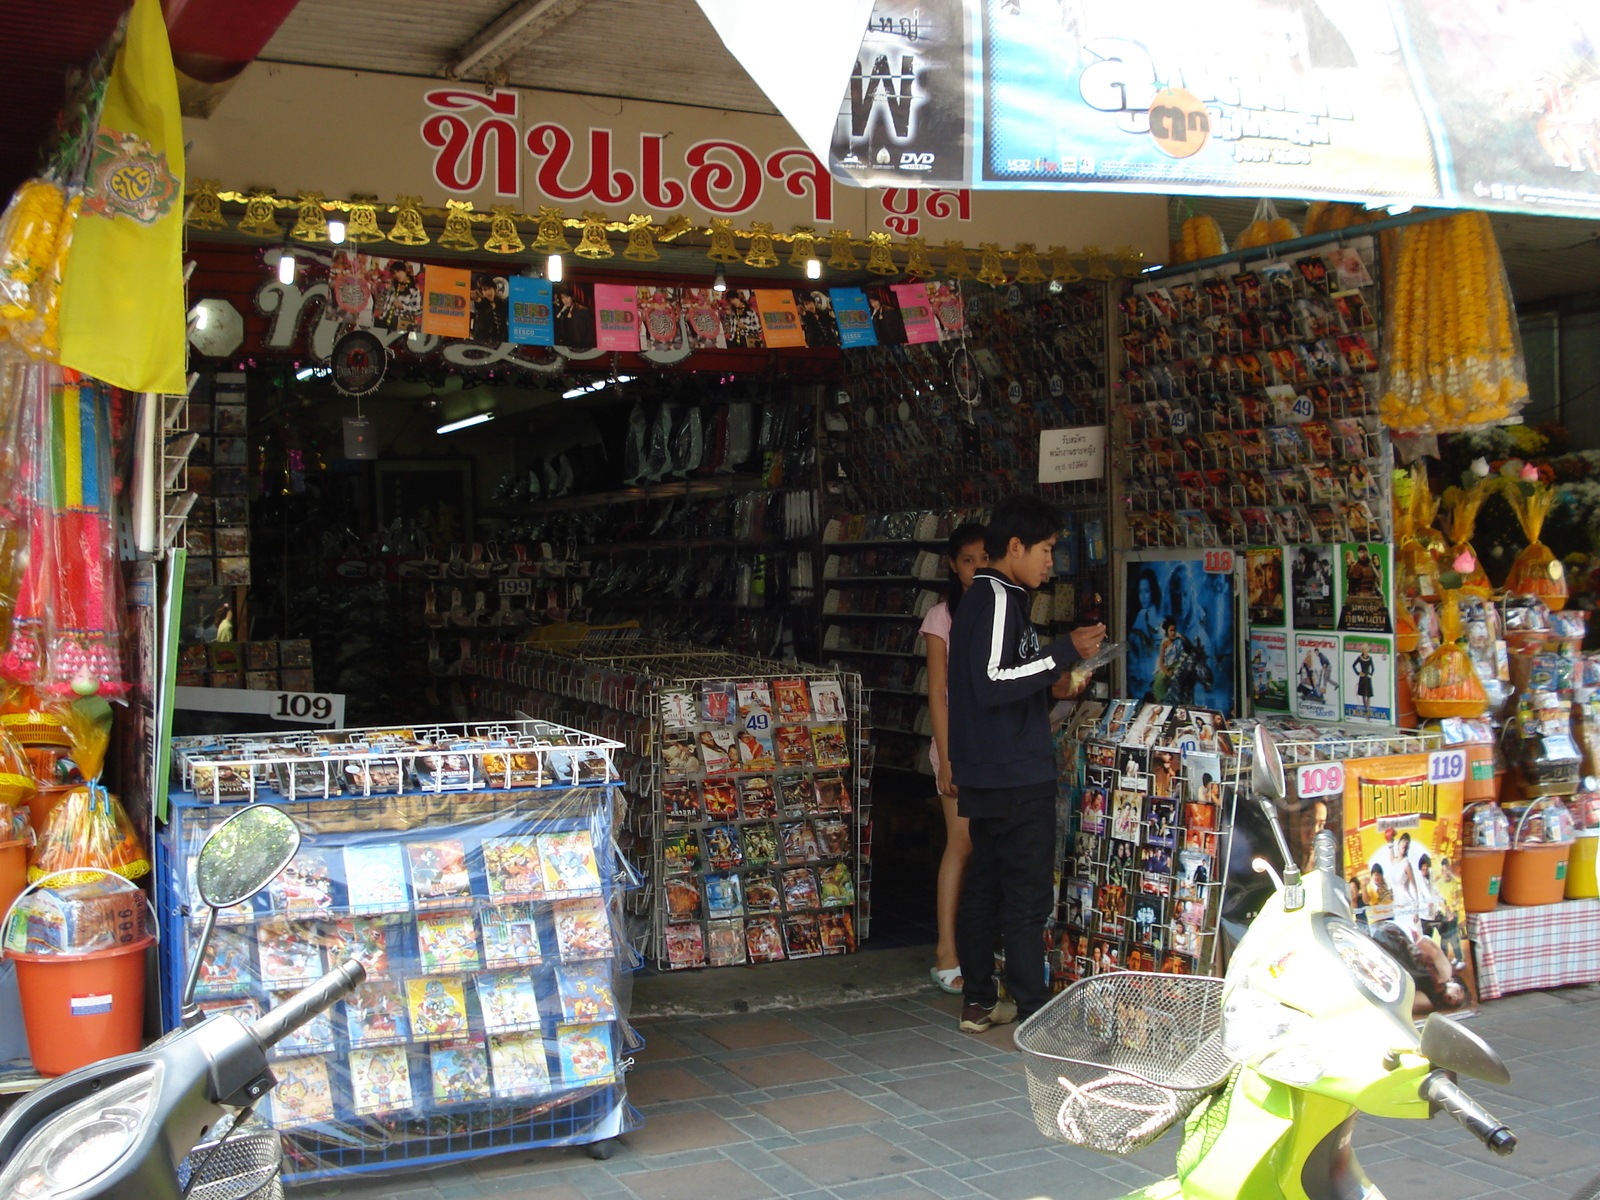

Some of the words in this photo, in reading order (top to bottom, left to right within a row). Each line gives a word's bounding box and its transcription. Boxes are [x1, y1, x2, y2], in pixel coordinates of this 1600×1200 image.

[422, 90, 834, 223] ทีนเอจ
[900, 153, 935, 164] DVD
[428, 292, 466, 310] BIRD
[513, 303, 550, 319] BIRD
[600, 309, 635, 324] BIRD
[762, 311, 796, 325] BIRD
[1009, 385, 1021, 398] 49
[1051, 381, 1063, 393] 49
[1293, 399, 1311, 416] 49
[1171, 412, 1185, 428] 49
[1205, 551, 1232, 572] 119
[500, 580, 530, 594] 199
[275, 692, 333, 720] 109
[746, 714, 769, 731] 49
[1431, 755, 1463, 781] 119
[1301, 767, 1342, 795] 109
